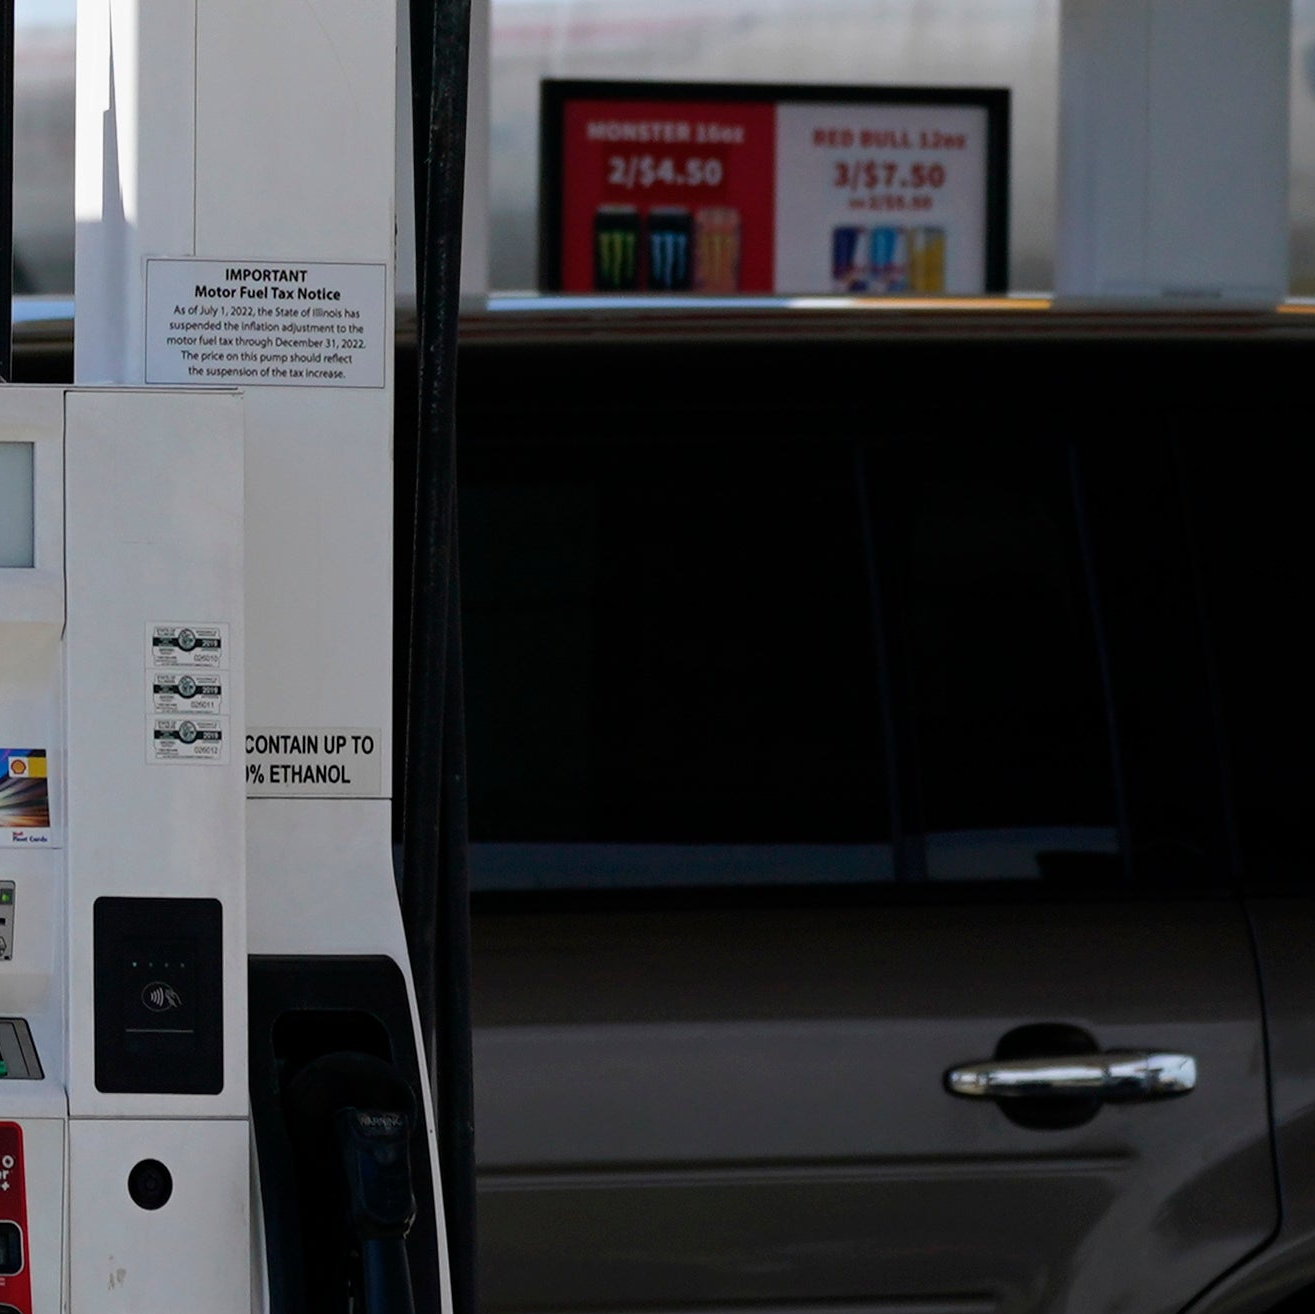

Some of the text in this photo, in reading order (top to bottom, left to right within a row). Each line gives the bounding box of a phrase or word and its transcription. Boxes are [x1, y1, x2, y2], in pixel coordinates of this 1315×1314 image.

[587, 121, 690, 143] MONSTER
[813, 129, 911, 148] RED BULL
[608, 155, 723, 188] 2/$4.50
[834, 160, 946, 191] 3/$7.50
[225, 268, 308, 282] IMPORTANT
[195, 285, 341, 300] Motor Fuel Tax Notice
[173, 305, 360, 319] As of July 1, 2022, the State of Illinois has
[169, 321, 364, 334] suspended the inflation adjustment to the
[166, 335, 366, 349] motor fuel tax through December 31, 2022.
[181, 350, 353, 364] The price on this pump should reflect
[245, 735, 374, 754] CONTAIN UP TO
[270, 765, 351, 783] ETHANOL
